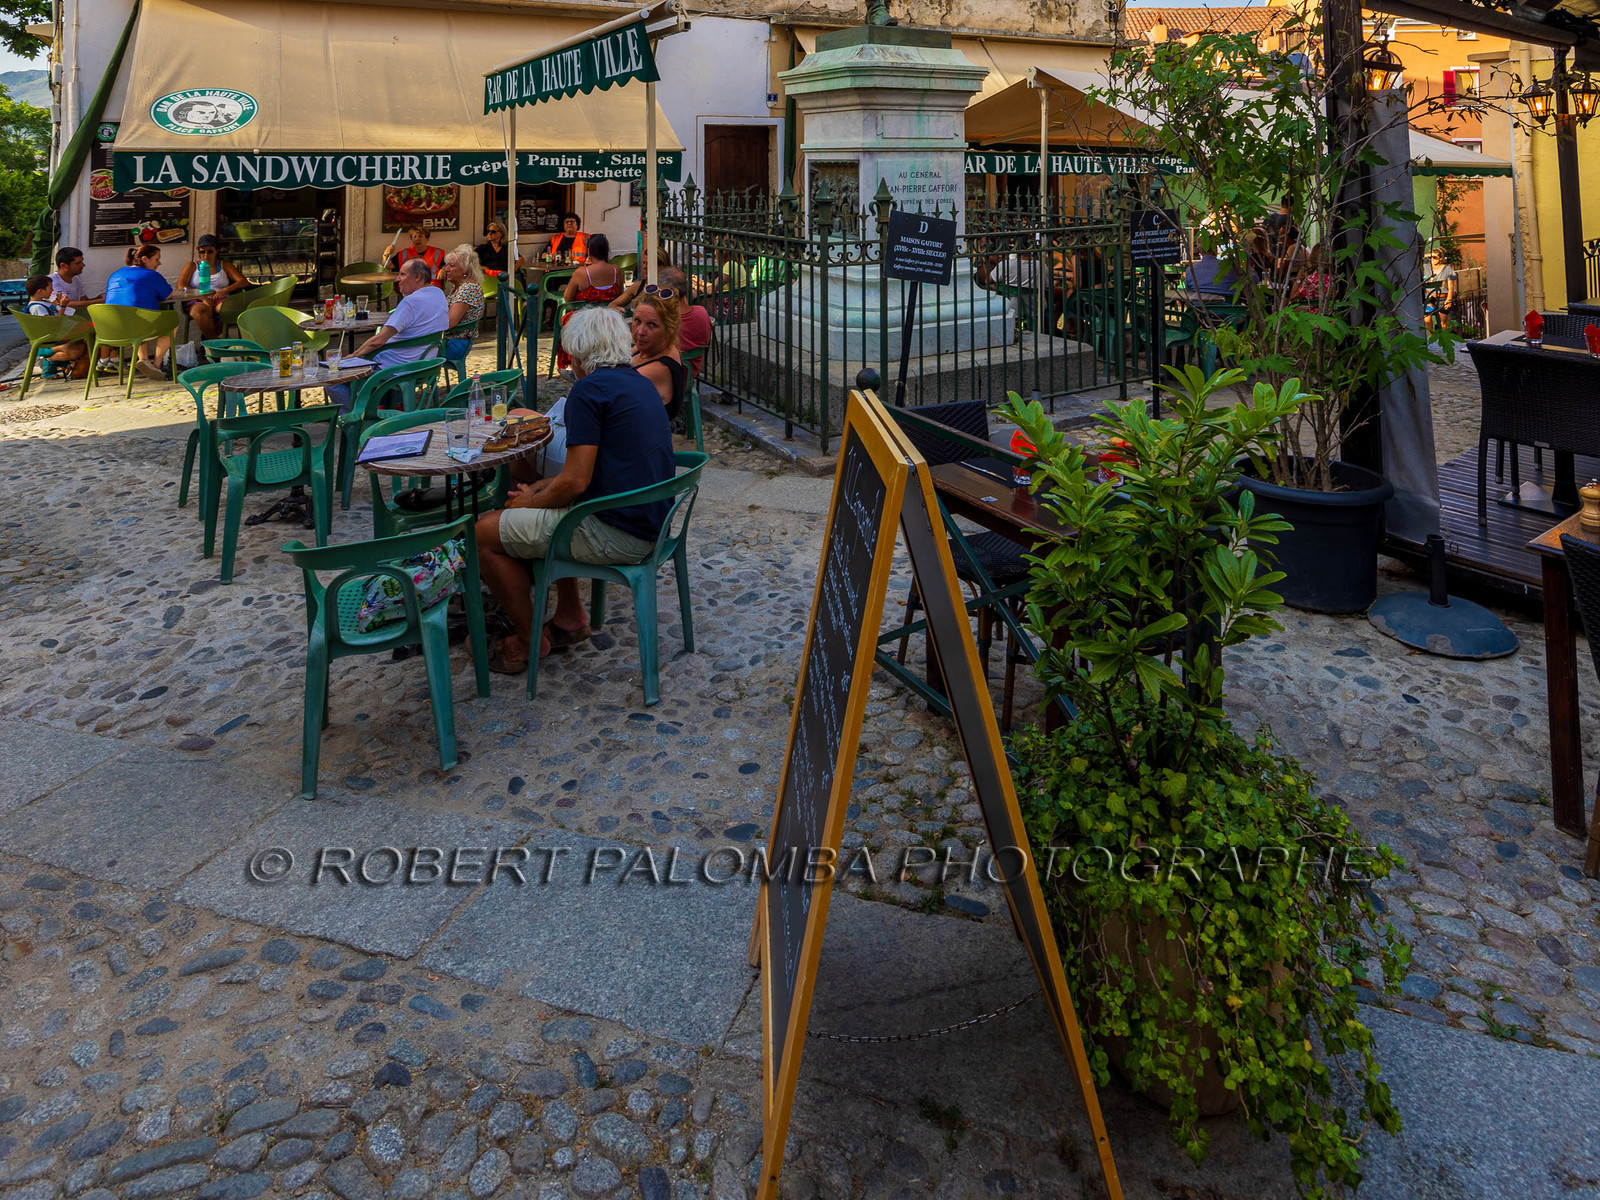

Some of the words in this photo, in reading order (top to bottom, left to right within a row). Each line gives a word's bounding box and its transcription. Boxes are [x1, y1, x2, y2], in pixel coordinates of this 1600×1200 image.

[486, 75, 503, 105] BAR
[506, 69, 519, 100] DE
[522, 63, 536, 98] LA
[541, 48, 583, 92] HAUTE
[592, 27, 643, 80] VILLE
[156, 100, 174, 112] BAR
[170, 93, 187, 102] DE
[205, 90, 241, 99] HAUTE
[237, 96, 253, 111] VILLE
[165, 123, 195, 134] PLACE
[199, 121, 241, 134] GAFFORY
[527, 154, 583, 166] Panini
[610, 153, 674, 166] Salaes
[963, 155, 987, 174] AR
[994, 155, 1017, 174] DE
[1024, 155, 1042, 174] LA
[1051, 155, 1103, 174] HAUTE
[1106, 157, 1149, 174] VILLE
[1152, 156, 1187, 166] Crêpe
[132, 154, 183, 184] LA
[191, 154, 452, 183] SANDWICHERIE
[557, 166, 642, 178] Bruschette
[898, 171, 908, 179] AU
[910, 171, 942, 179] GÉNÉRAL
[887, 184, 927, 193] AN-PIERRE
[928, 184, 957, 193] GAFFORI
[422, 217, 457, 227] BHV
[1152, 214, 1159, 226] C
[918, 221, 929, 234] D
[900, 236, 920, 245] MAISON
[920, 239, 944, 249] GAFFORY
